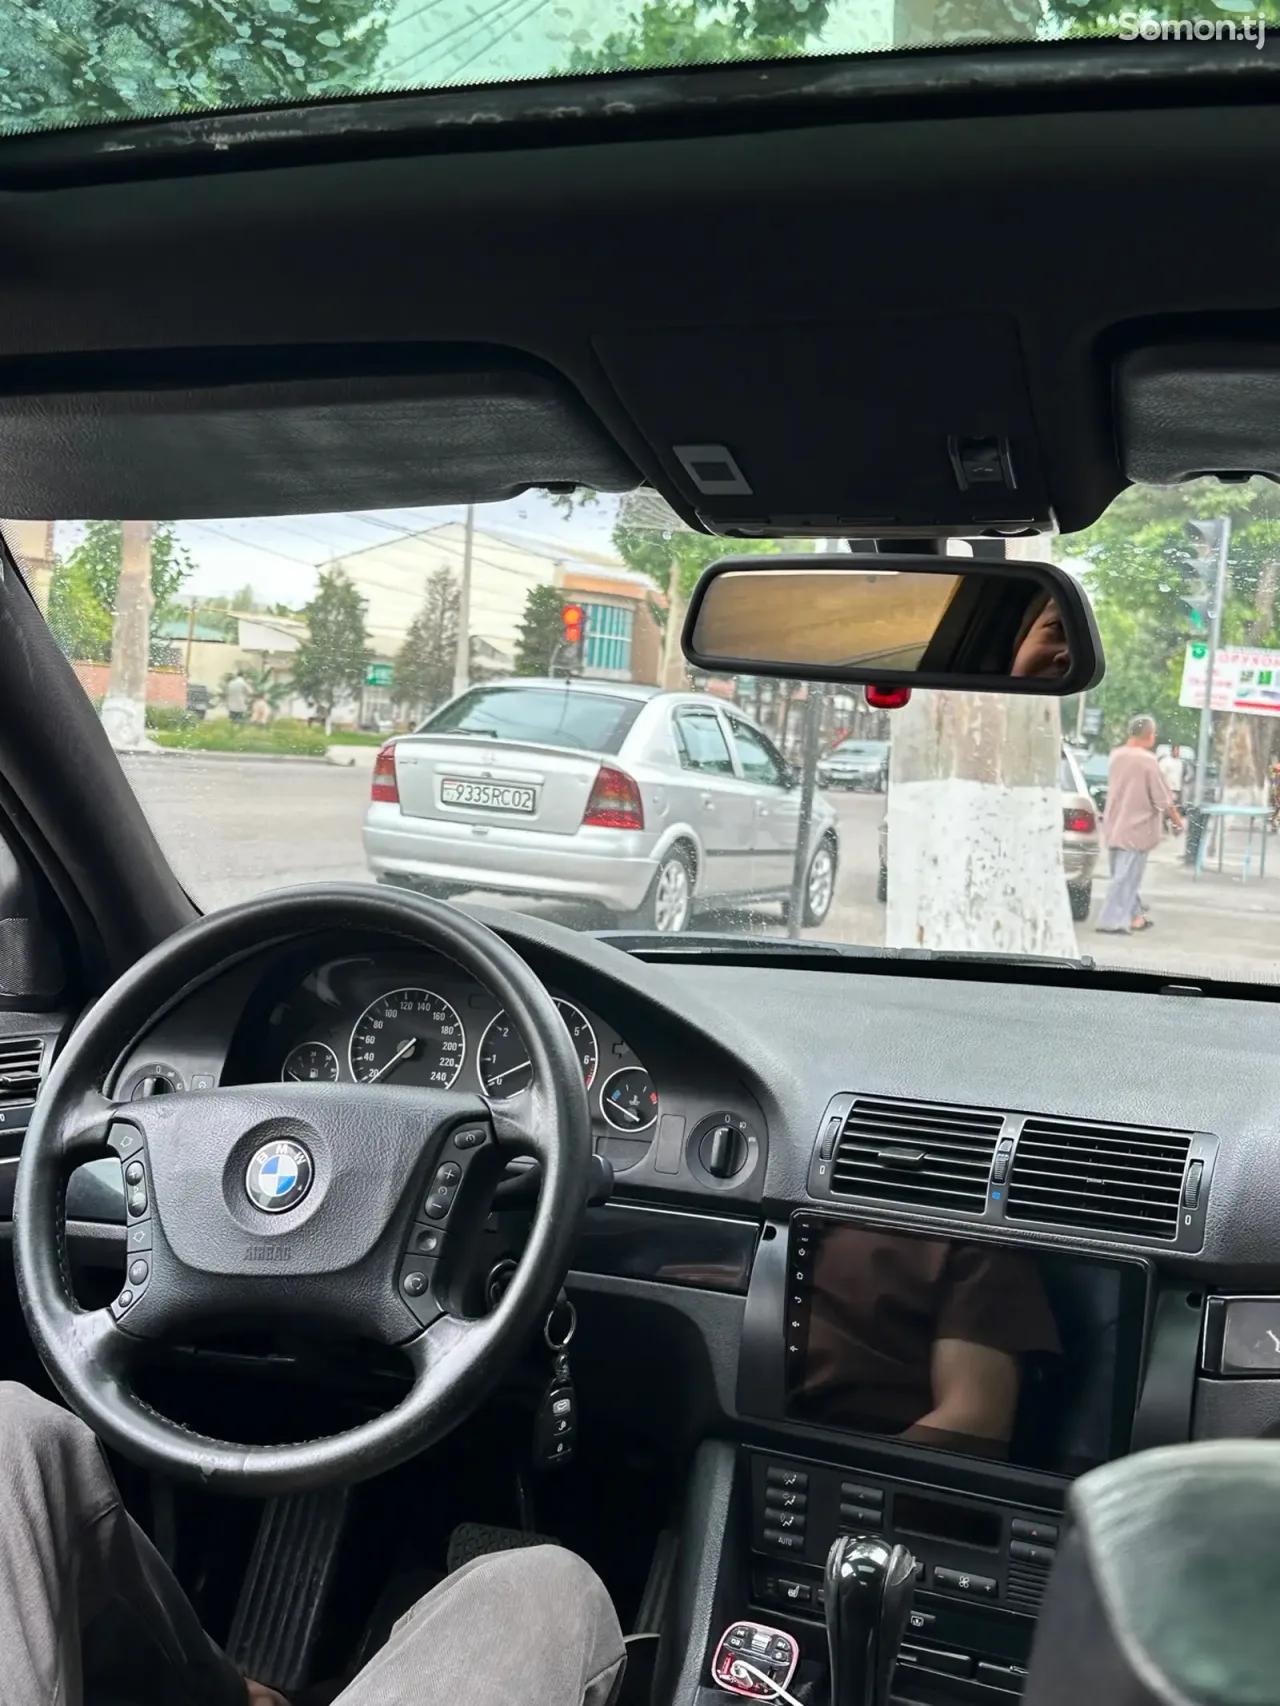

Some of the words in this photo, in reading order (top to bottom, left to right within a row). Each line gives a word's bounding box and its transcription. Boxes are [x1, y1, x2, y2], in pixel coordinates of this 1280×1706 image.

[456, 784, 531, 808] 9335RC02
[401, 1001, 413, 1011] 120
[417, 1002, 431, 1012] 140
[385, 1009, 398, 1018] 100
[433, 1012, 446, 1021] 160
[373, 1021, 384, 1029] 80
[441, 1025, 454, 1035] 180
[502, 1027, 509, 1037] 2
[574, 1027, 580, 1036] 5
[365, 1036, 376, 1044] 60
[442, 1041, 457, 1051] 200
[363, 1052, 375, 1062] 40
[583, 1055, 589, 1064] 6
[439, 1058, 454, 1067] 220
[430, 1072, 447, 1081] 240
[256, 1144, 306, 1165] BMW
